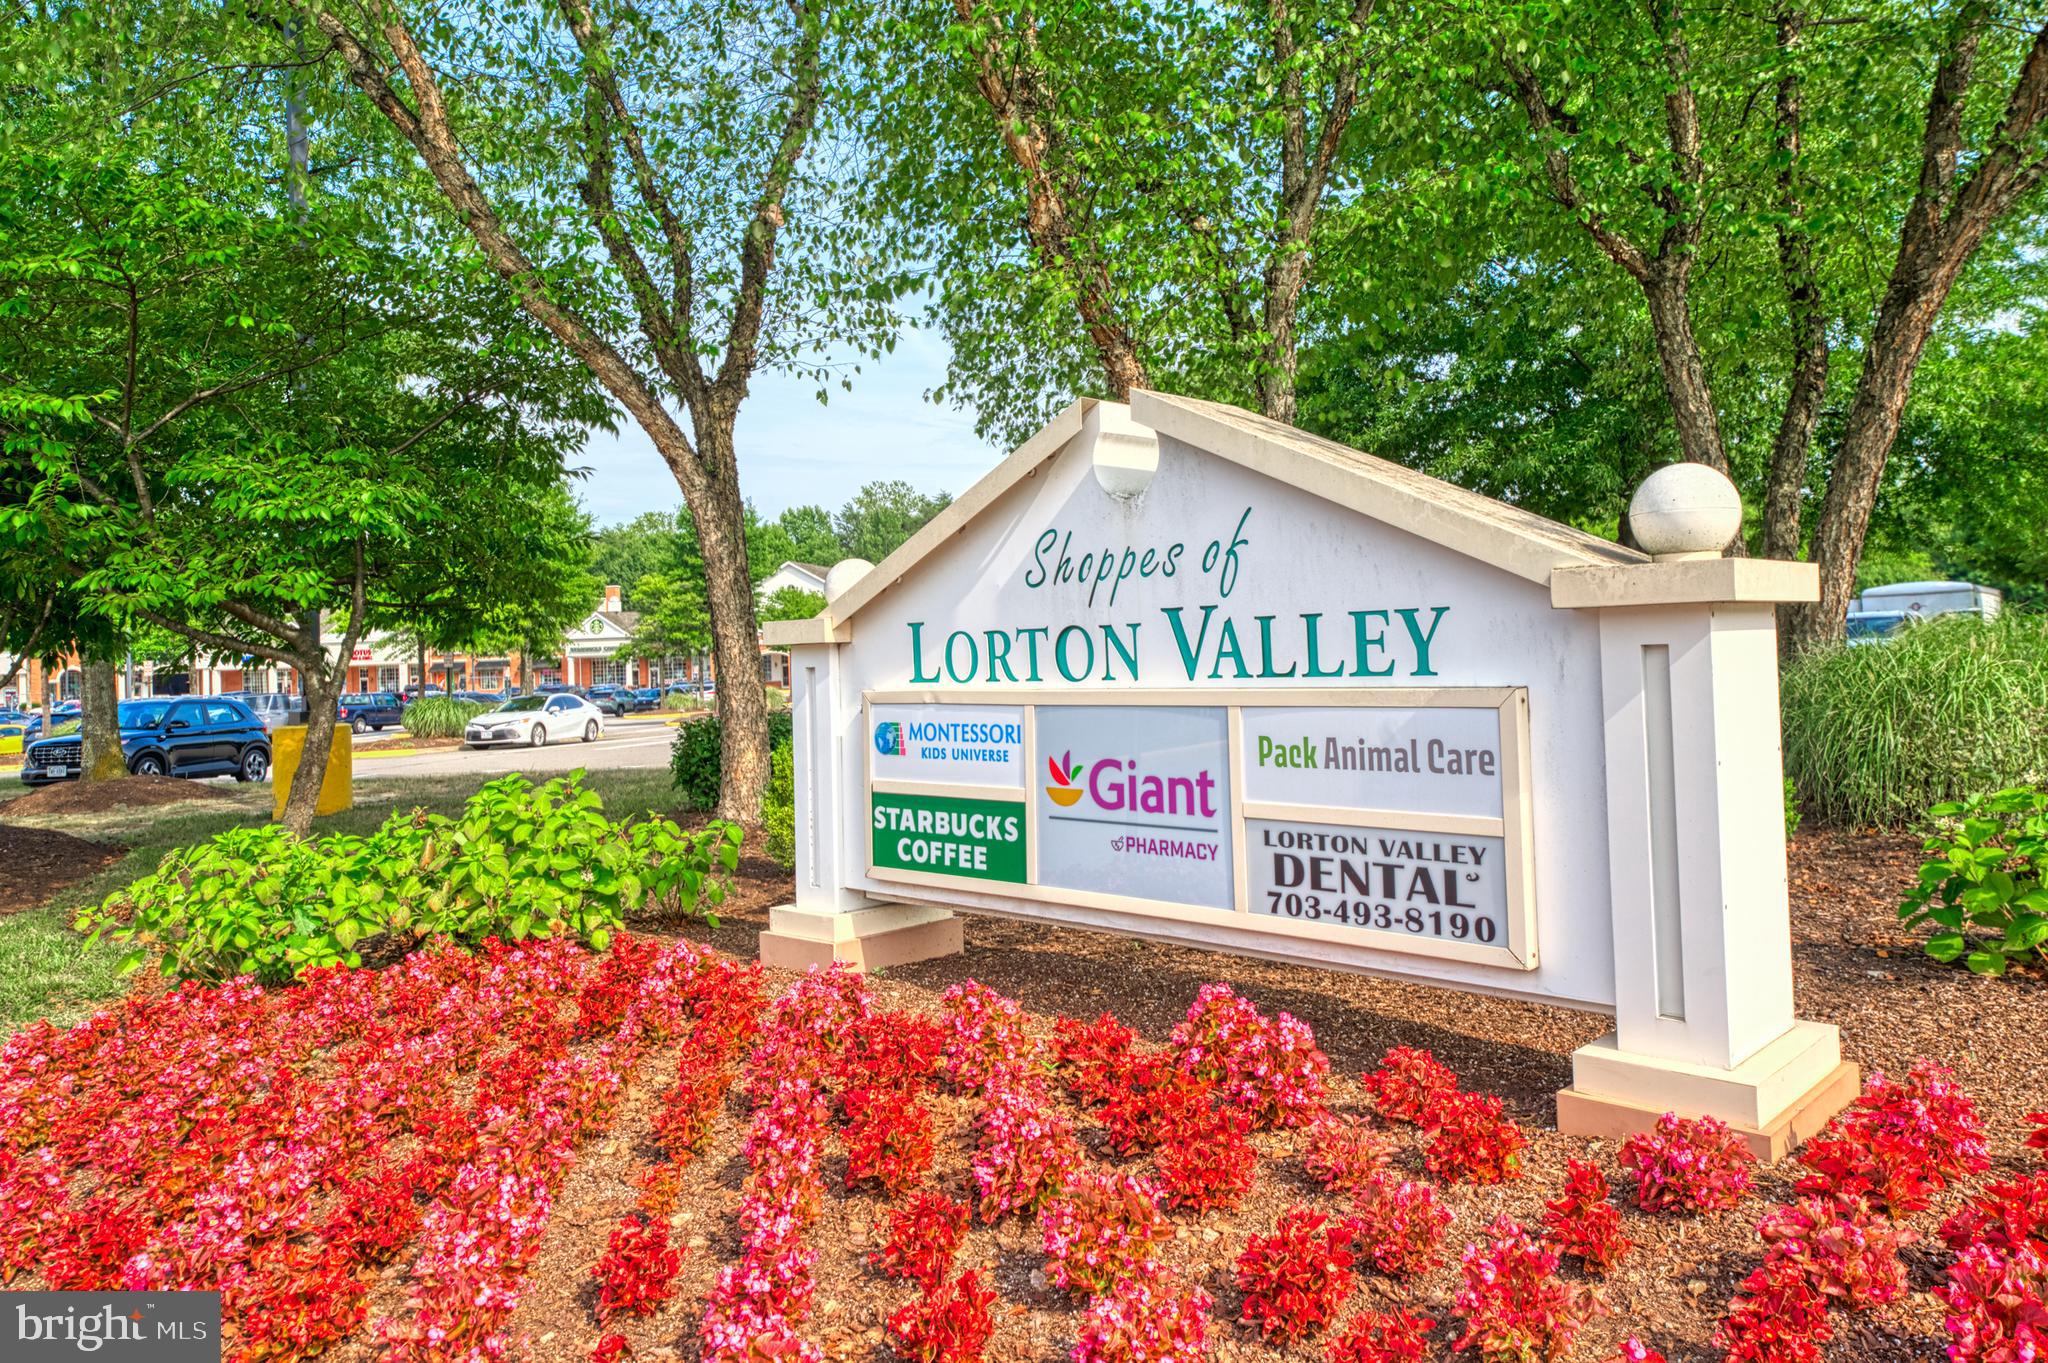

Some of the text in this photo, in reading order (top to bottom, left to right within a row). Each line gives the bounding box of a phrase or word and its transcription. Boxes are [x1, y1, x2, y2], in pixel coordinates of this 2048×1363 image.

[1025, 506, 1253, 608] Shoppes of
[907, 604, 1451, 684] LORTON VALLEY
[909, 722, 1021, 744] MONTESSORI
[921, 747, 1009, 762] KIDS UNIVERSE
[1258, 735, 1495, 776] Pack Animal Care
[1089, 758, 1217, 818] Giant
[874, 805, 1019, 842] STARBUCKS
[897, 837, 988, 871] COFFEE
[1126, 836, 1218, 861] PHARMACY
[1263, 830, 1487, 866] LORTON VALLEY
[1273, 852, 1476, 909] DENTAL
[1267, 891, 1496, 943] 703-493-8190
